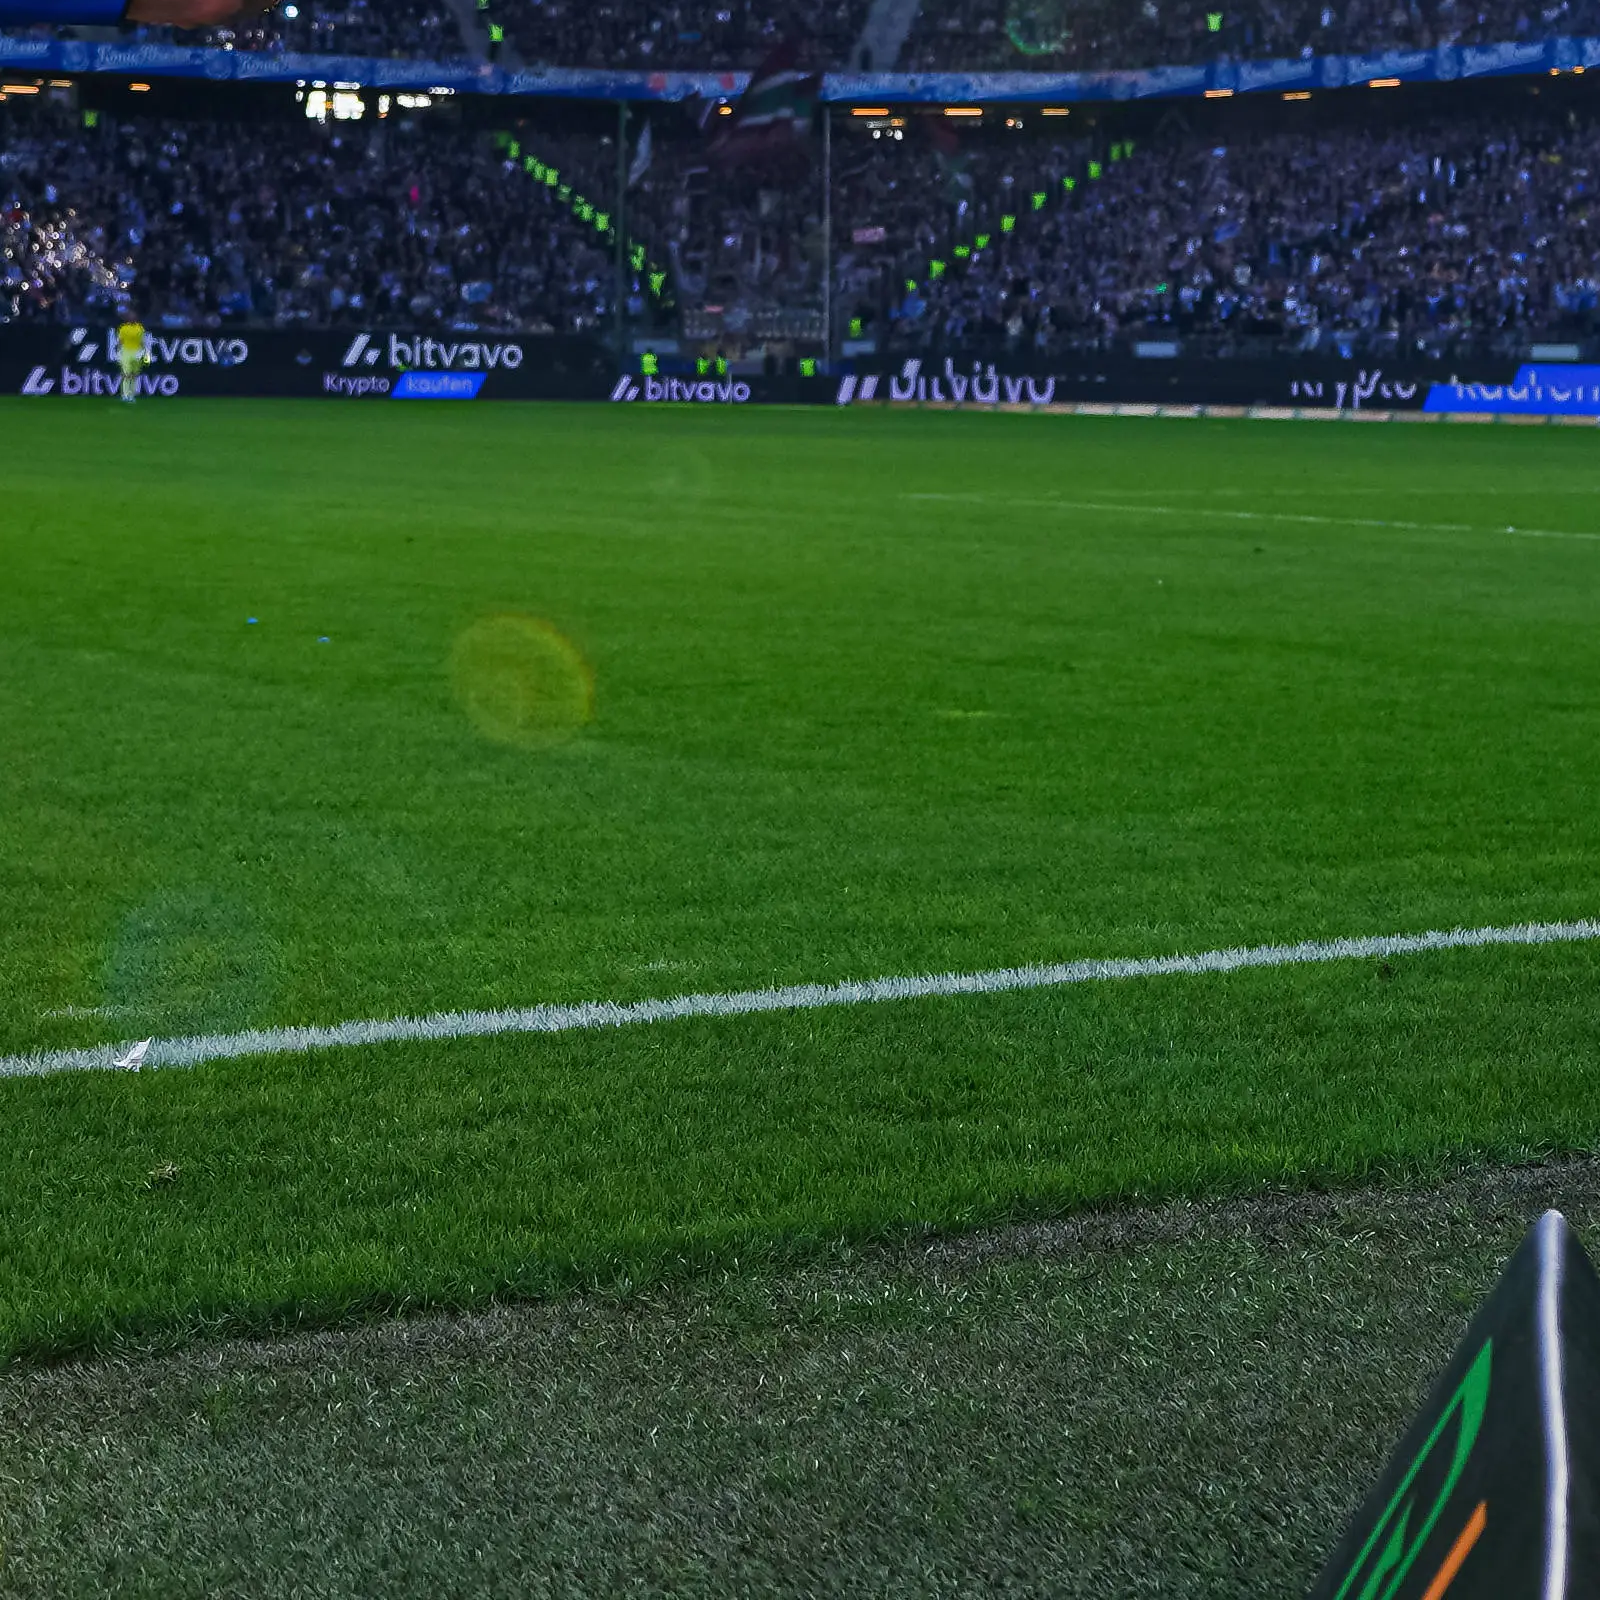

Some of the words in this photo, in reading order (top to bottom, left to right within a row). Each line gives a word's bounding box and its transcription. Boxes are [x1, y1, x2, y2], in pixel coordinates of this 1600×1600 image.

[390, 333, 523, 368] bitvavo
[323, 372, 390, 396] Krypto
[645, 375, 750, 401] bitvavo
